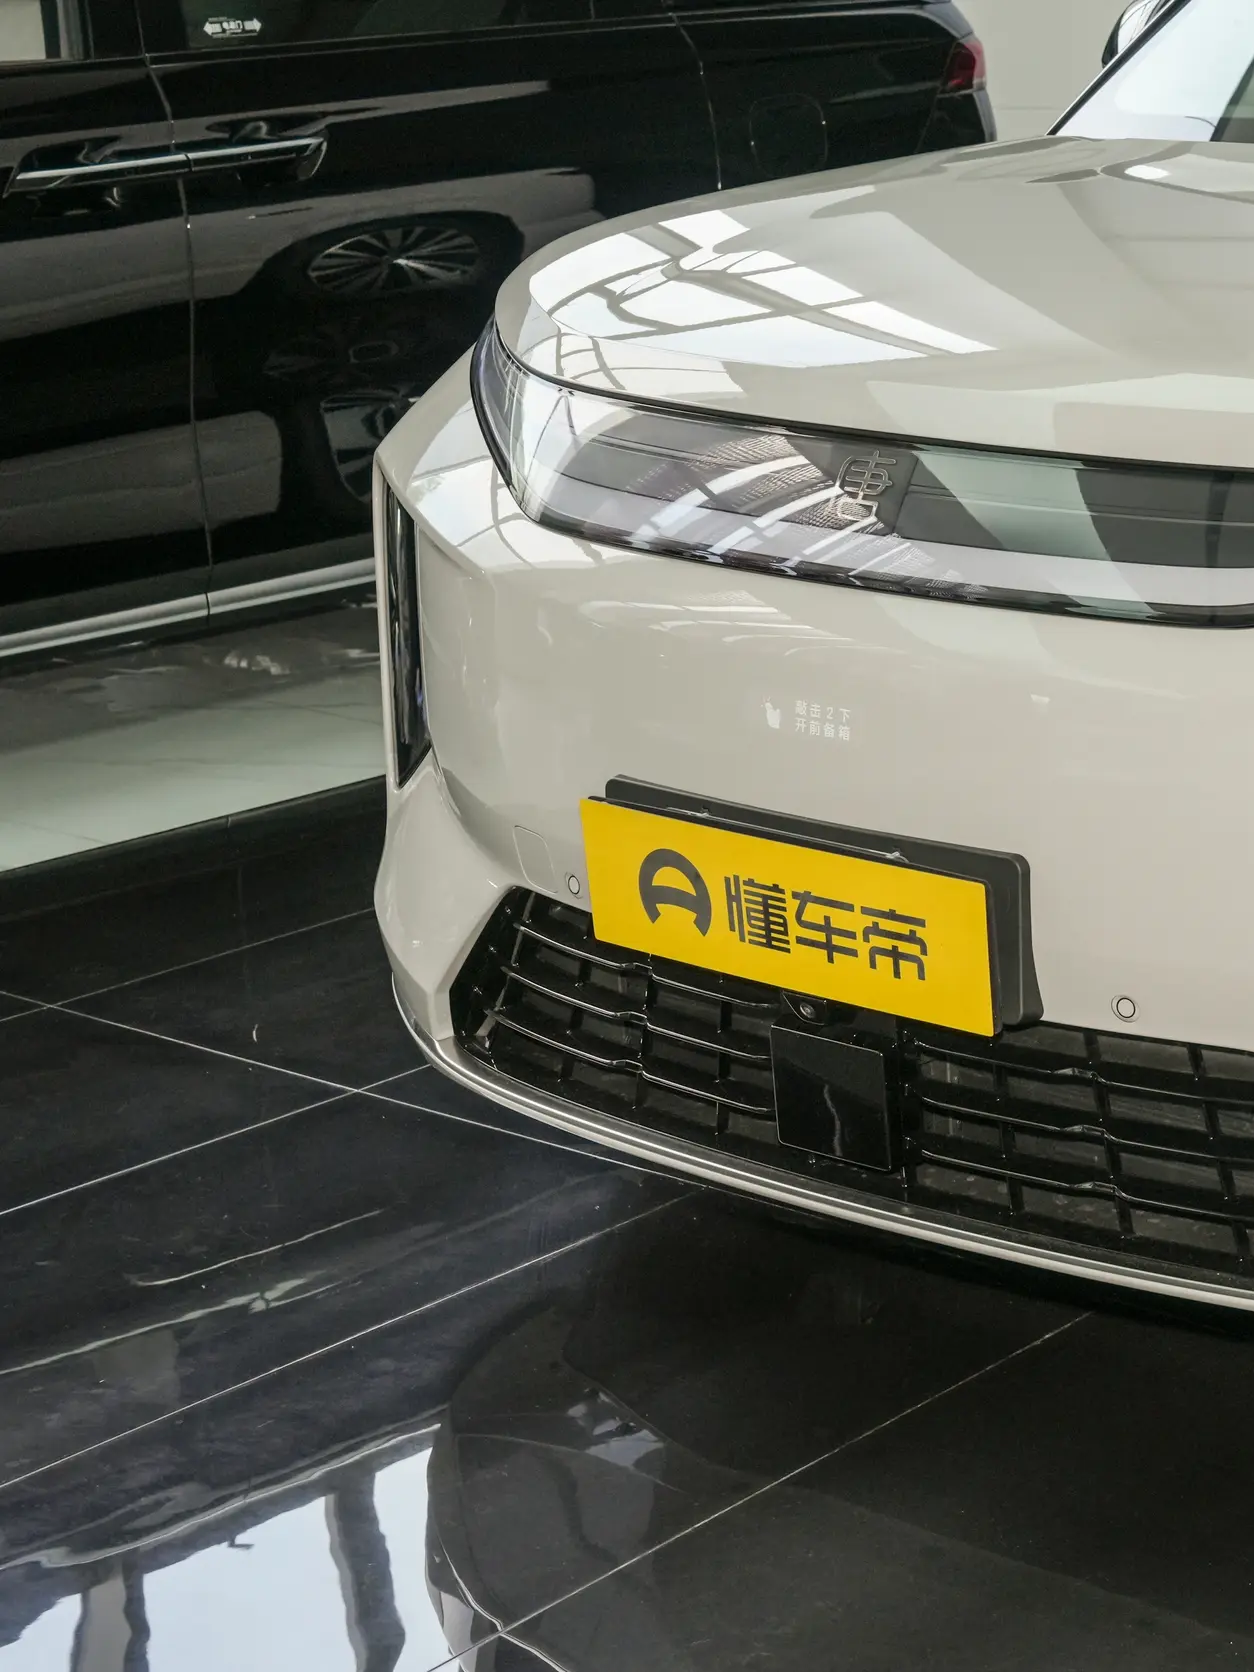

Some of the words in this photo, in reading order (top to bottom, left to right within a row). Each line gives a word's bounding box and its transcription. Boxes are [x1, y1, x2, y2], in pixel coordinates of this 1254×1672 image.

[794, 717, 851, 741] 开前备箱
[724, 874, 928, 981] 懂车帝
